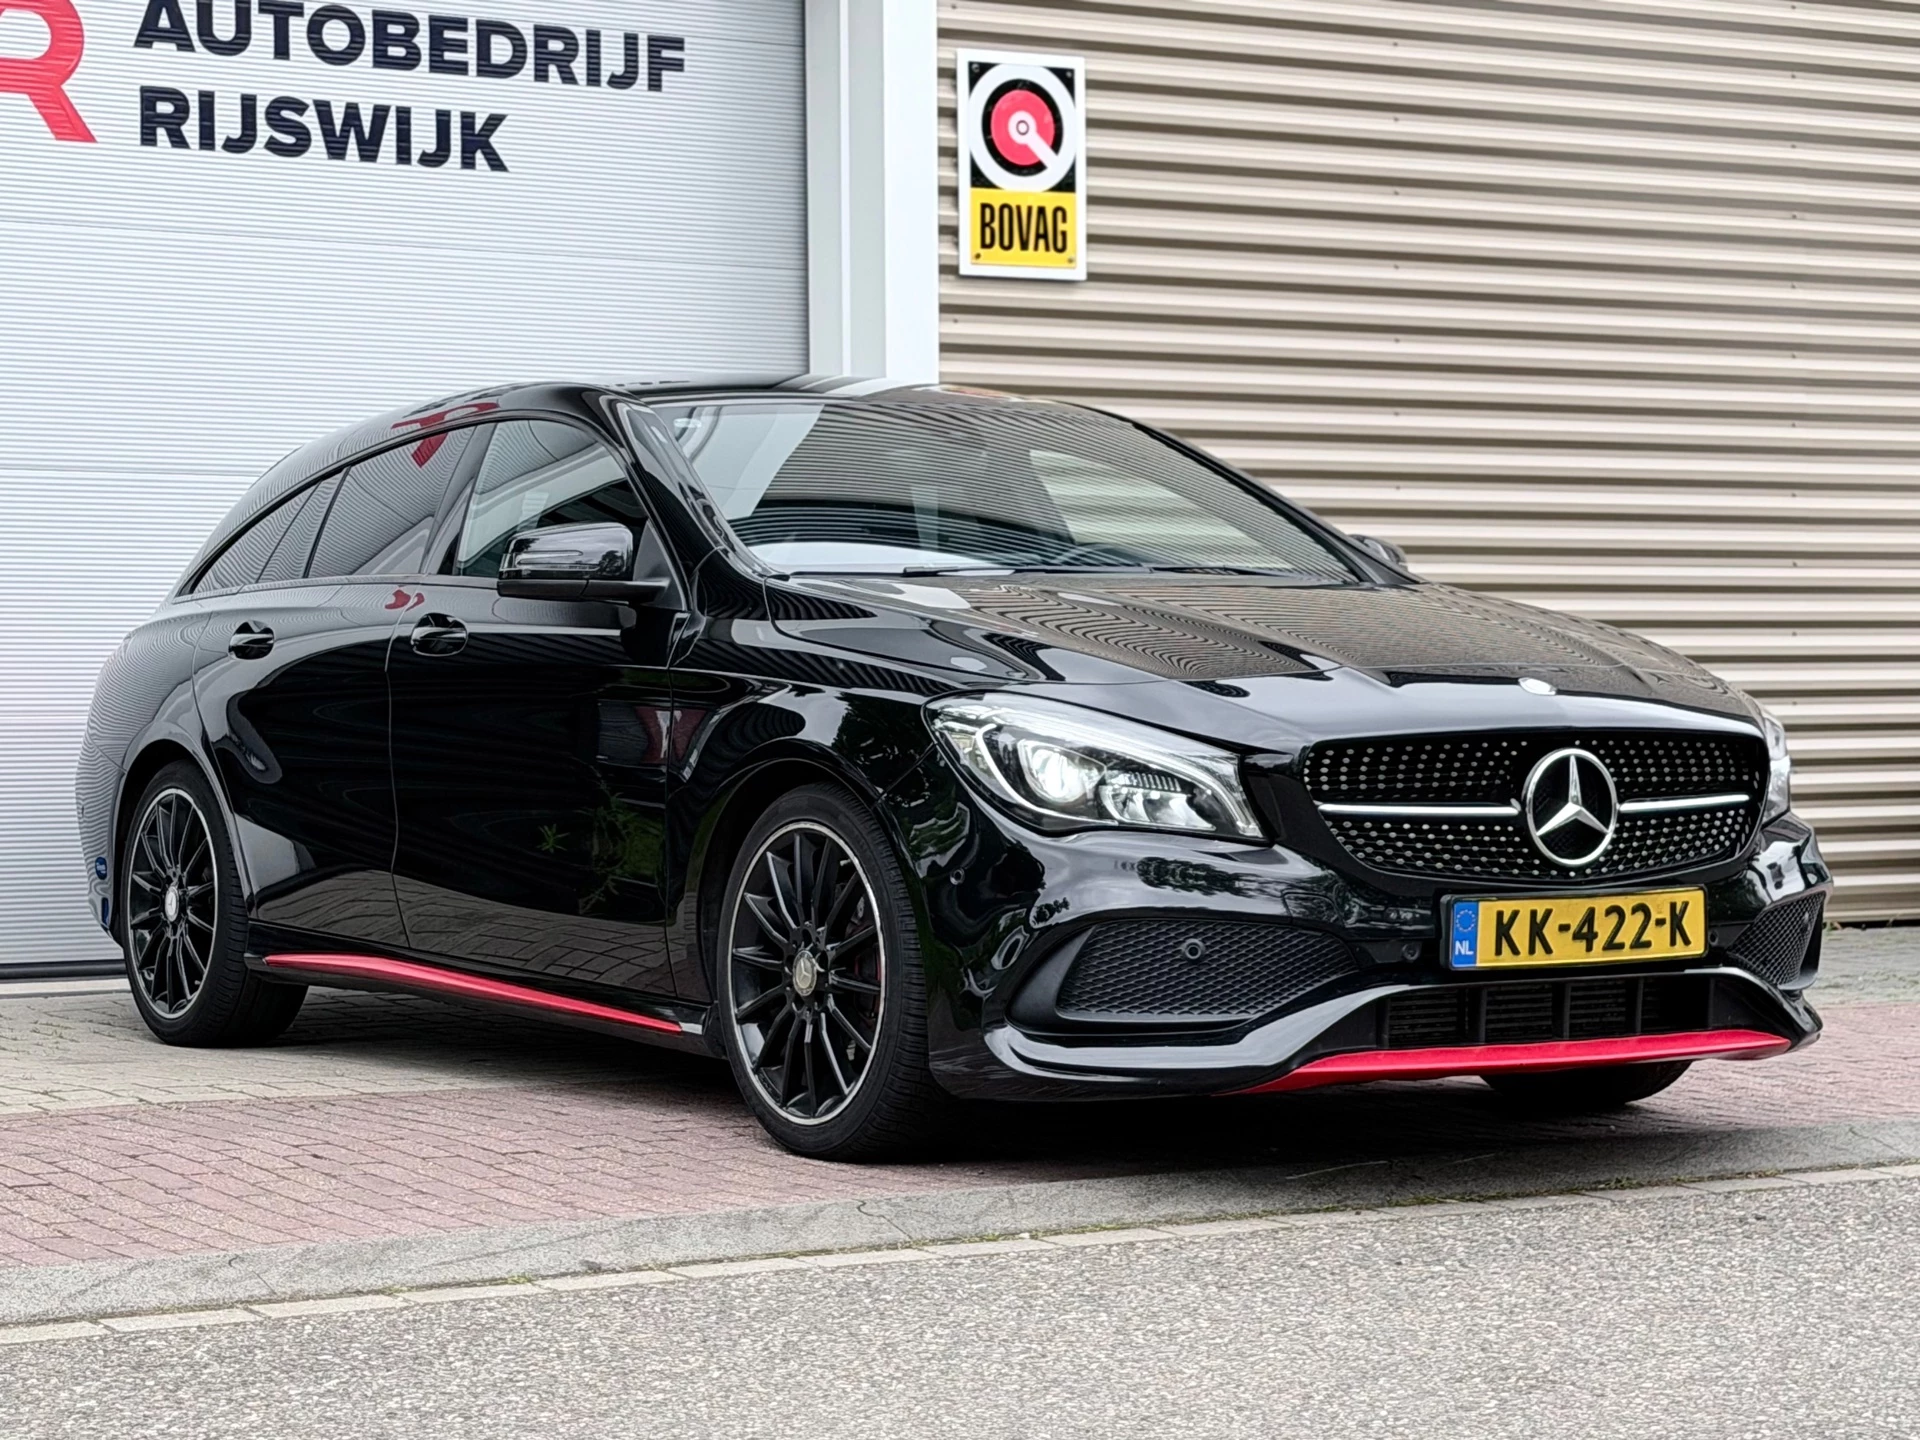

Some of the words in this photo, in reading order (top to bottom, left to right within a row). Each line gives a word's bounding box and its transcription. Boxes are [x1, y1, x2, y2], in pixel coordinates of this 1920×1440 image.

[133, 0, 685, 92] AUTOBEDRIJF
[139, 85, 510, 172] RIJSWIJK
[979, 202, 1068, 254] BOVAG
[1454, 940, 1474, 956] NL
[1494, 900, 1692, 957] KK-422-K
